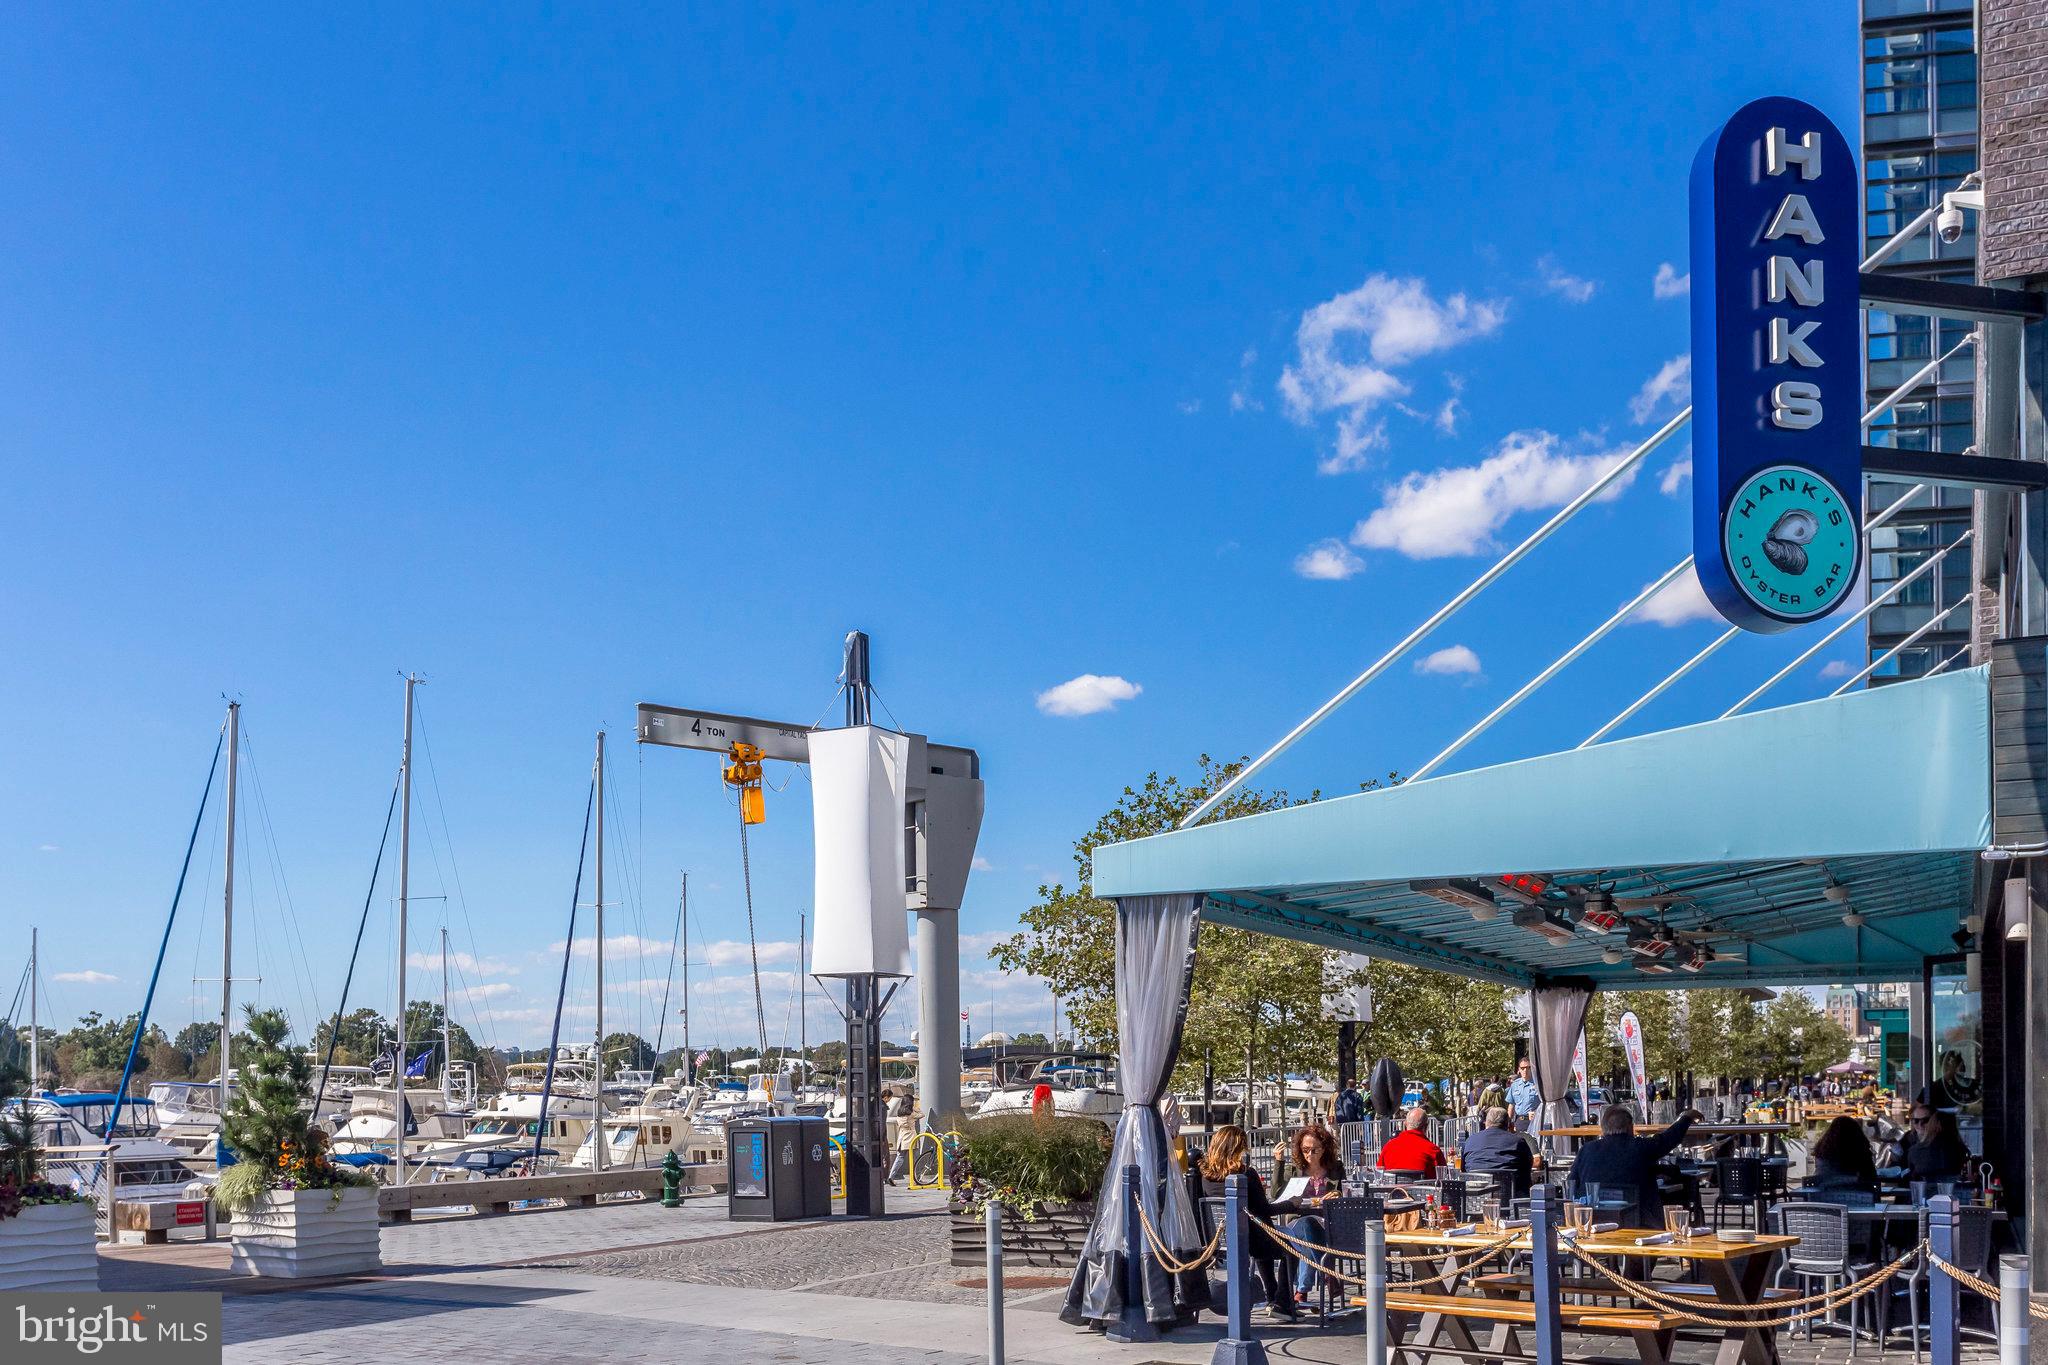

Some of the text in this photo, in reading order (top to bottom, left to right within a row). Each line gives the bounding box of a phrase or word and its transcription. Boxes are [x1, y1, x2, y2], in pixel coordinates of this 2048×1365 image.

[1764, 127, 1825, 431] HANKS
[1740, 478, 1843, 527] HANK'S
[1742, 556, 1841, 605] OYSTER BAR
[691, 718, 726, 738] 4 TON
[751, 1133, 764, 1180] clean
